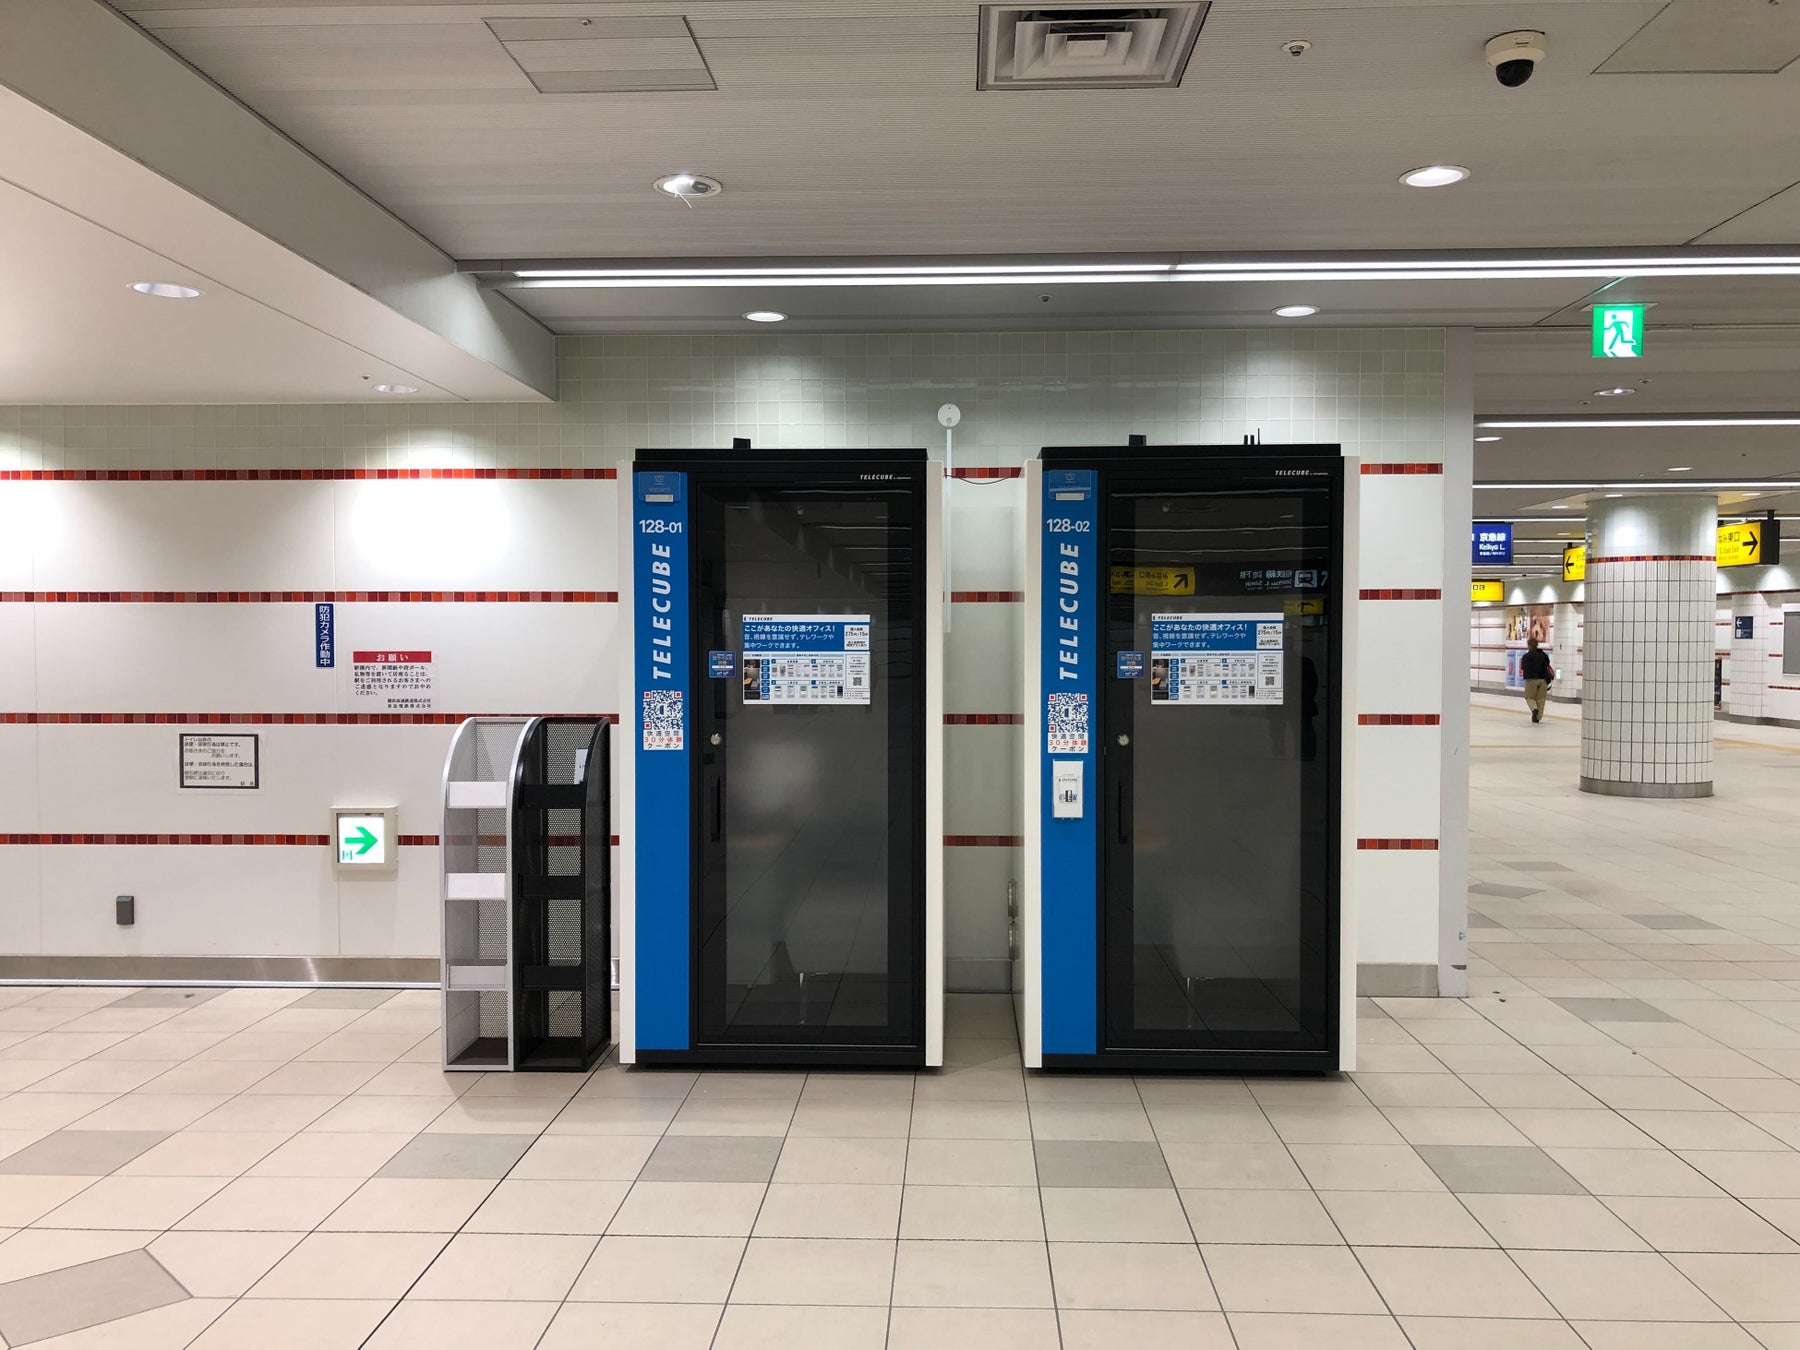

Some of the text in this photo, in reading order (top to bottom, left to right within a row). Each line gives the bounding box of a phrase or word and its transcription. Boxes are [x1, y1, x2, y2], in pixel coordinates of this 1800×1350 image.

[639, 519, 682, 534] 128-01
[1046, 518, 1090, 532] 128-02
[1479, 532, 1506, 542] 京急線
[652, 543, 672, 680] TELECUBE
[1060, 543, 1079, 680] TELECUBE
[319, 605, 330, 666] 防犯カメラ作動中
[376, 653, 408, 662] お願い
